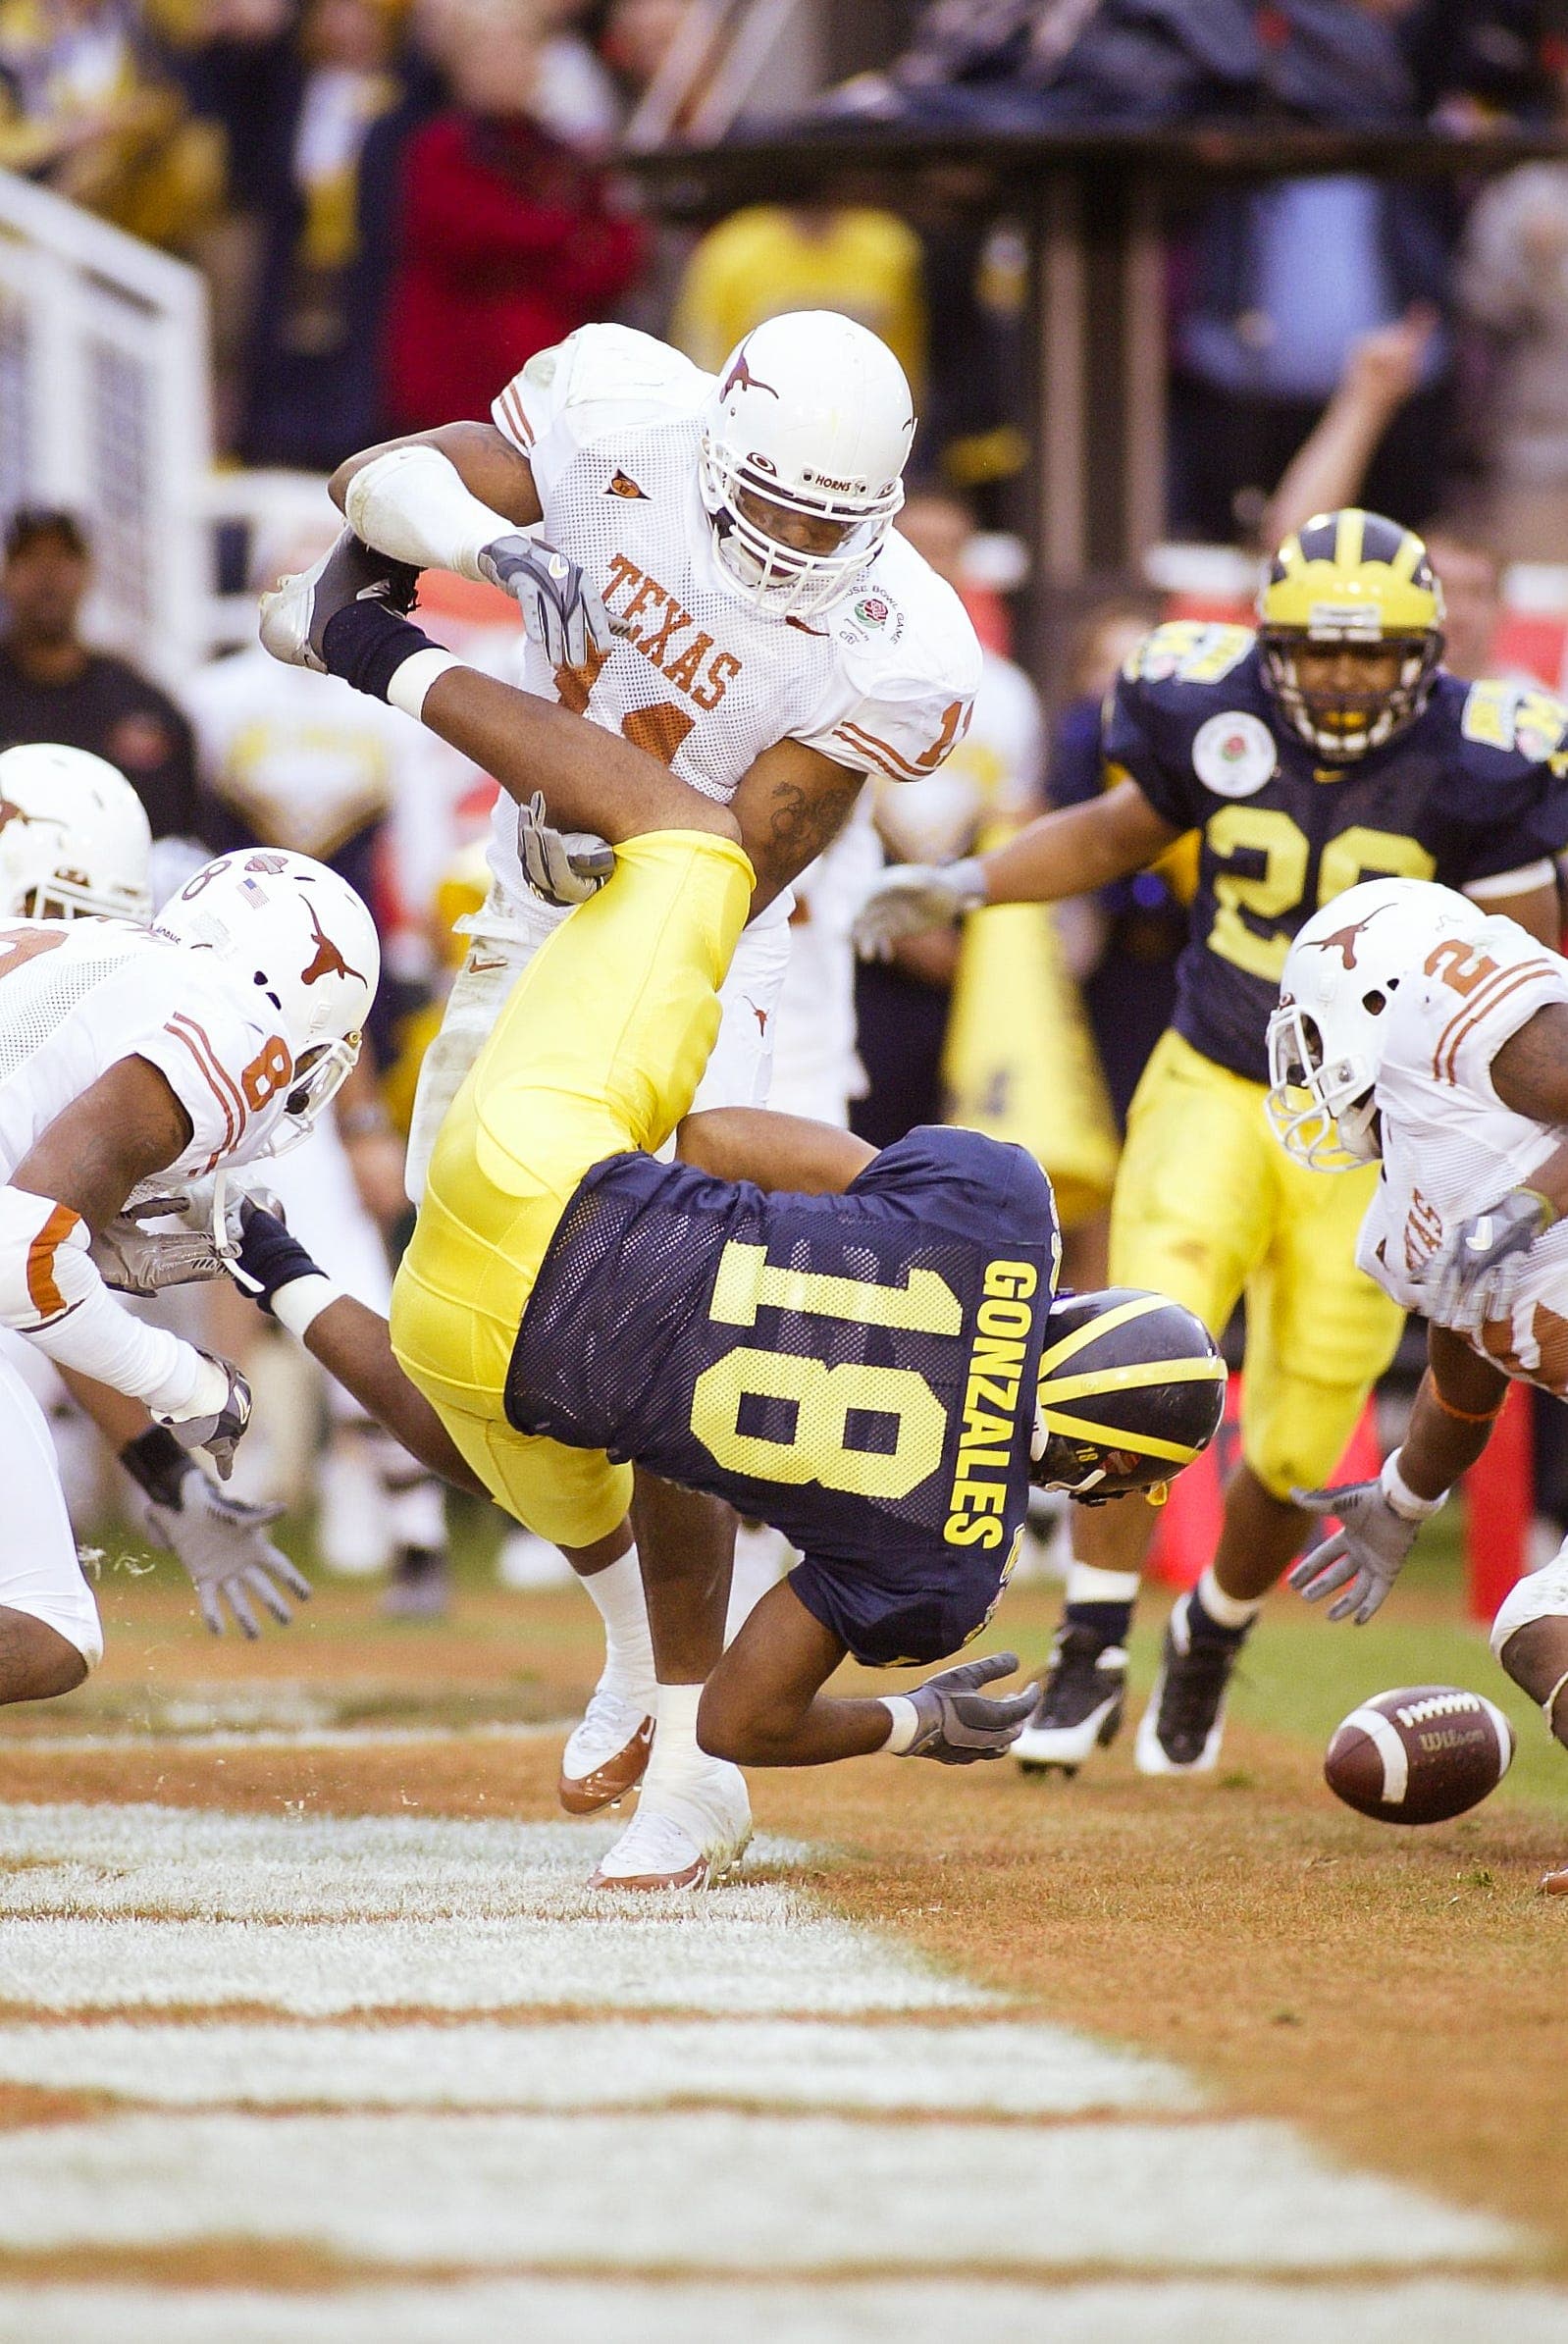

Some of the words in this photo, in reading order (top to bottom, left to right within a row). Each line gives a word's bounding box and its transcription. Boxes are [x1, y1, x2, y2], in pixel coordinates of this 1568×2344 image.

[815, 475, 852, 492] HORNS
[872, 585, 899, 610] BOWL
[601, 552, 743, 712] TEXAS
[182, 859, 232, 901] 8
[1424, 938, 1501, 997] 2
[241, 1033, 292, 1113] 8
[690, 1238, 964, 1501] 18
[943, 1259, 1038, 1550] GONZALES
[1074, 1446, 1099, 1463] 18
[1419, 1729, 1486, 1752] Wilson
